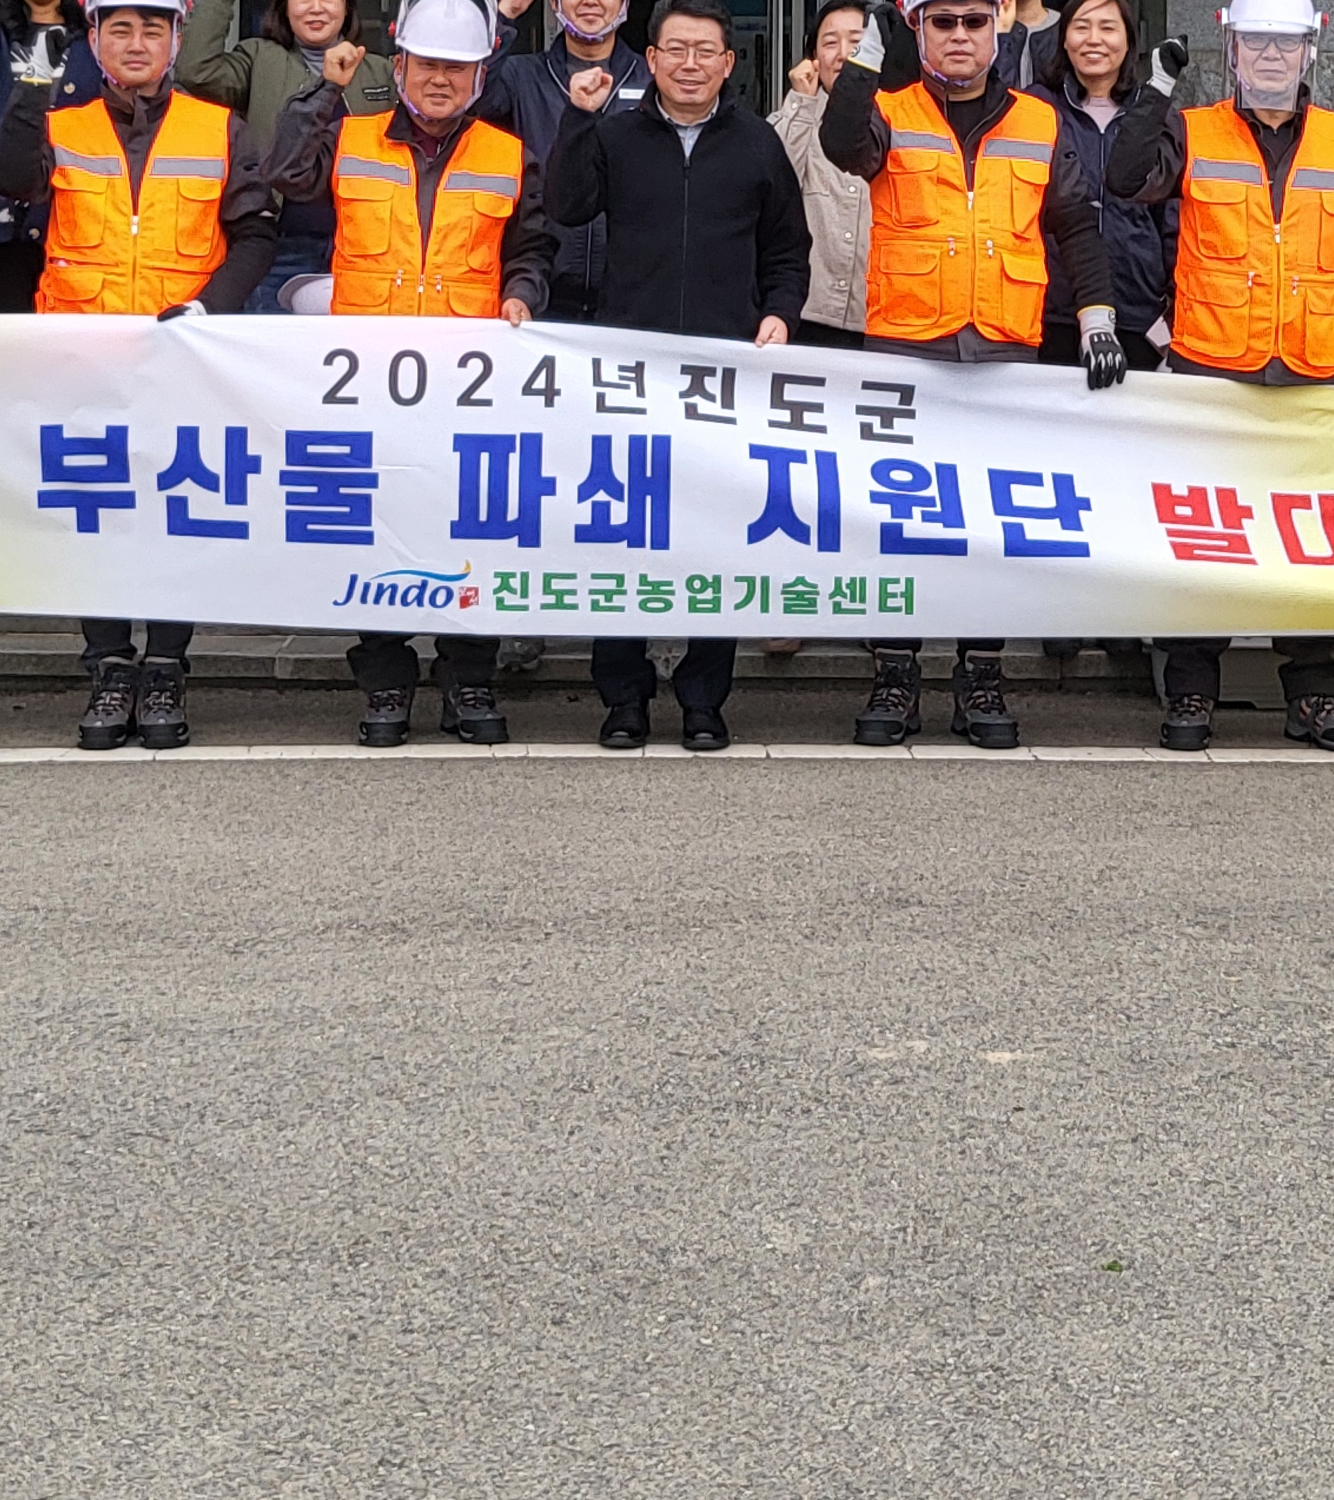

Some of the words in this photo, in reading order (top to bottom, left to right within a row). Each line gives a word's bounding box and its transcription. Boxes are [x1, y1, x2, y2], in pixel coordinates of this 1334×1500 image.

[37, 425, 379, 546] 부산물
[449, 432, 671, 551] 파쇄
[747, 443, 1092, 558] 지원단
[332, 573, 454, 609] Jindo
[493, 570, 915, 616] 진도군농업기술센터
